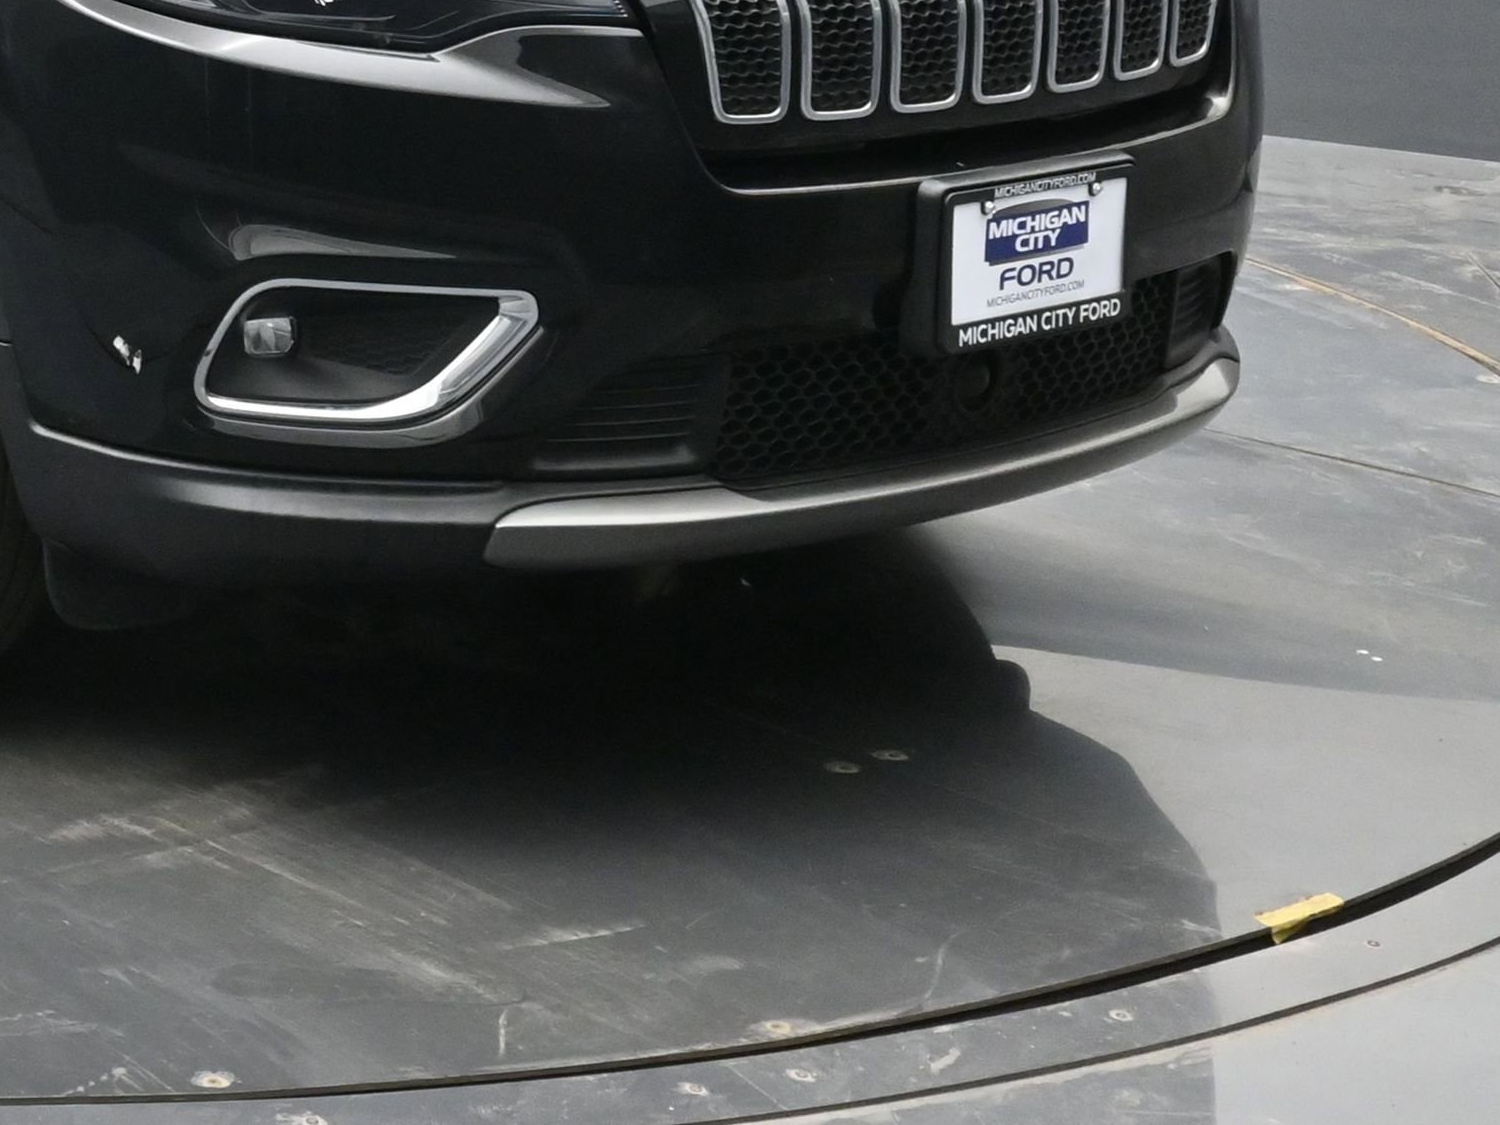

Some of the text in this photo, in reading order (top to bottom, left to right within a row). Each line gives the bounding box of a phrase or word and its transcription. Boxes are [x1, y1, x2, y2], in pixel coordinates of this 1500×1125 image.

[994, 171, 1097, 198] MICHIGANCITYFORD.COM
[988, 205, 1087, 239] MICHIGAN
[1014, 228, 1062, 253] CITY
[999, 256, 1075, 291] FORD
[986, 279, 1085, 308] MICHIGANCITYFORD.COM
[958, 298, 1121, 348] MICHIGAN CITY FORD
